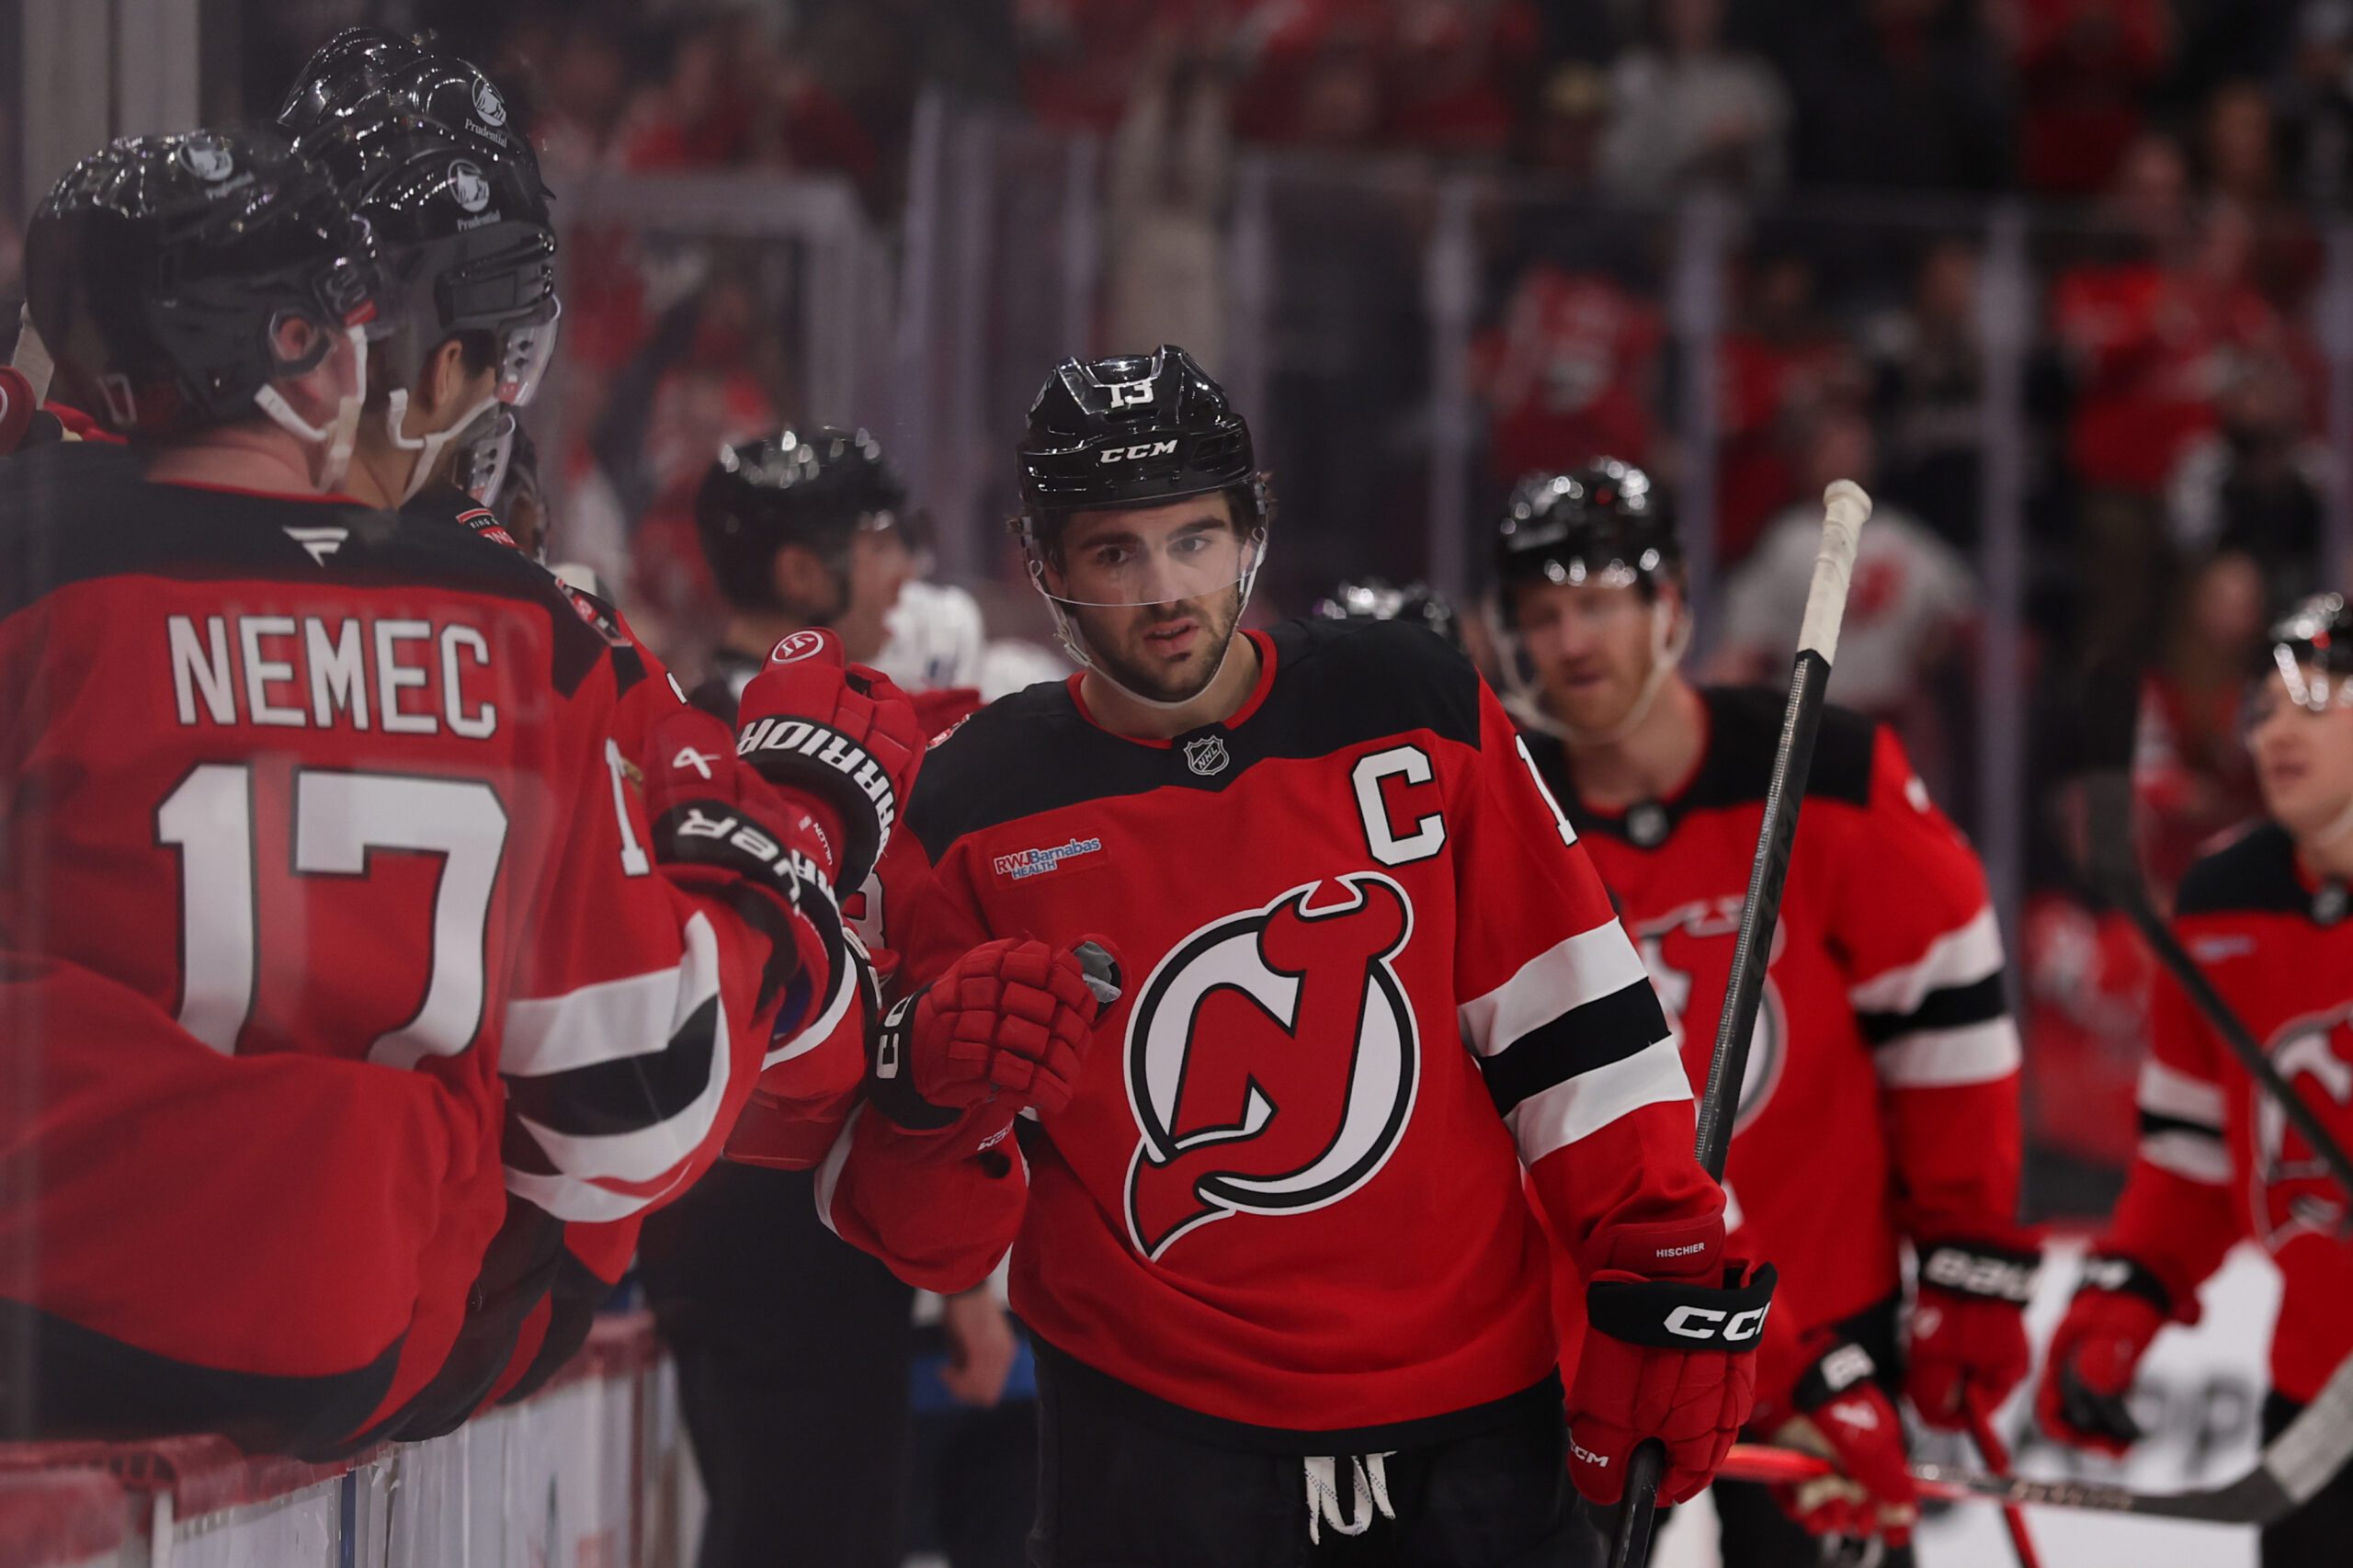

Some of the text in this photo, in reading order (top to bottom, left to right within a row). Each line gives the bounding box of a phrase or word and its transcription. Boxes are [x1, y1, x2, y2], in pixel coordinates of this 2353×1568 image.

[465, 118, 507, 148] Prudential
[1109, 380, 1154, 409] 13
[1099, 438, 1179, 464] CCM
[167, 614, 497, 739] NEMEC
[1198, 746, 1219, 770] NHL
[736, 718, 894, 872] ARRIOR
[1352, 744, 1448, 867] C
[1012, 859, 1058, 880] HEALTH
[157, 763, 508, 1072] 17
[1656, 1243, 1705, 1258] HISCHIER
[1663, 1301, 1771, 1342] CC
